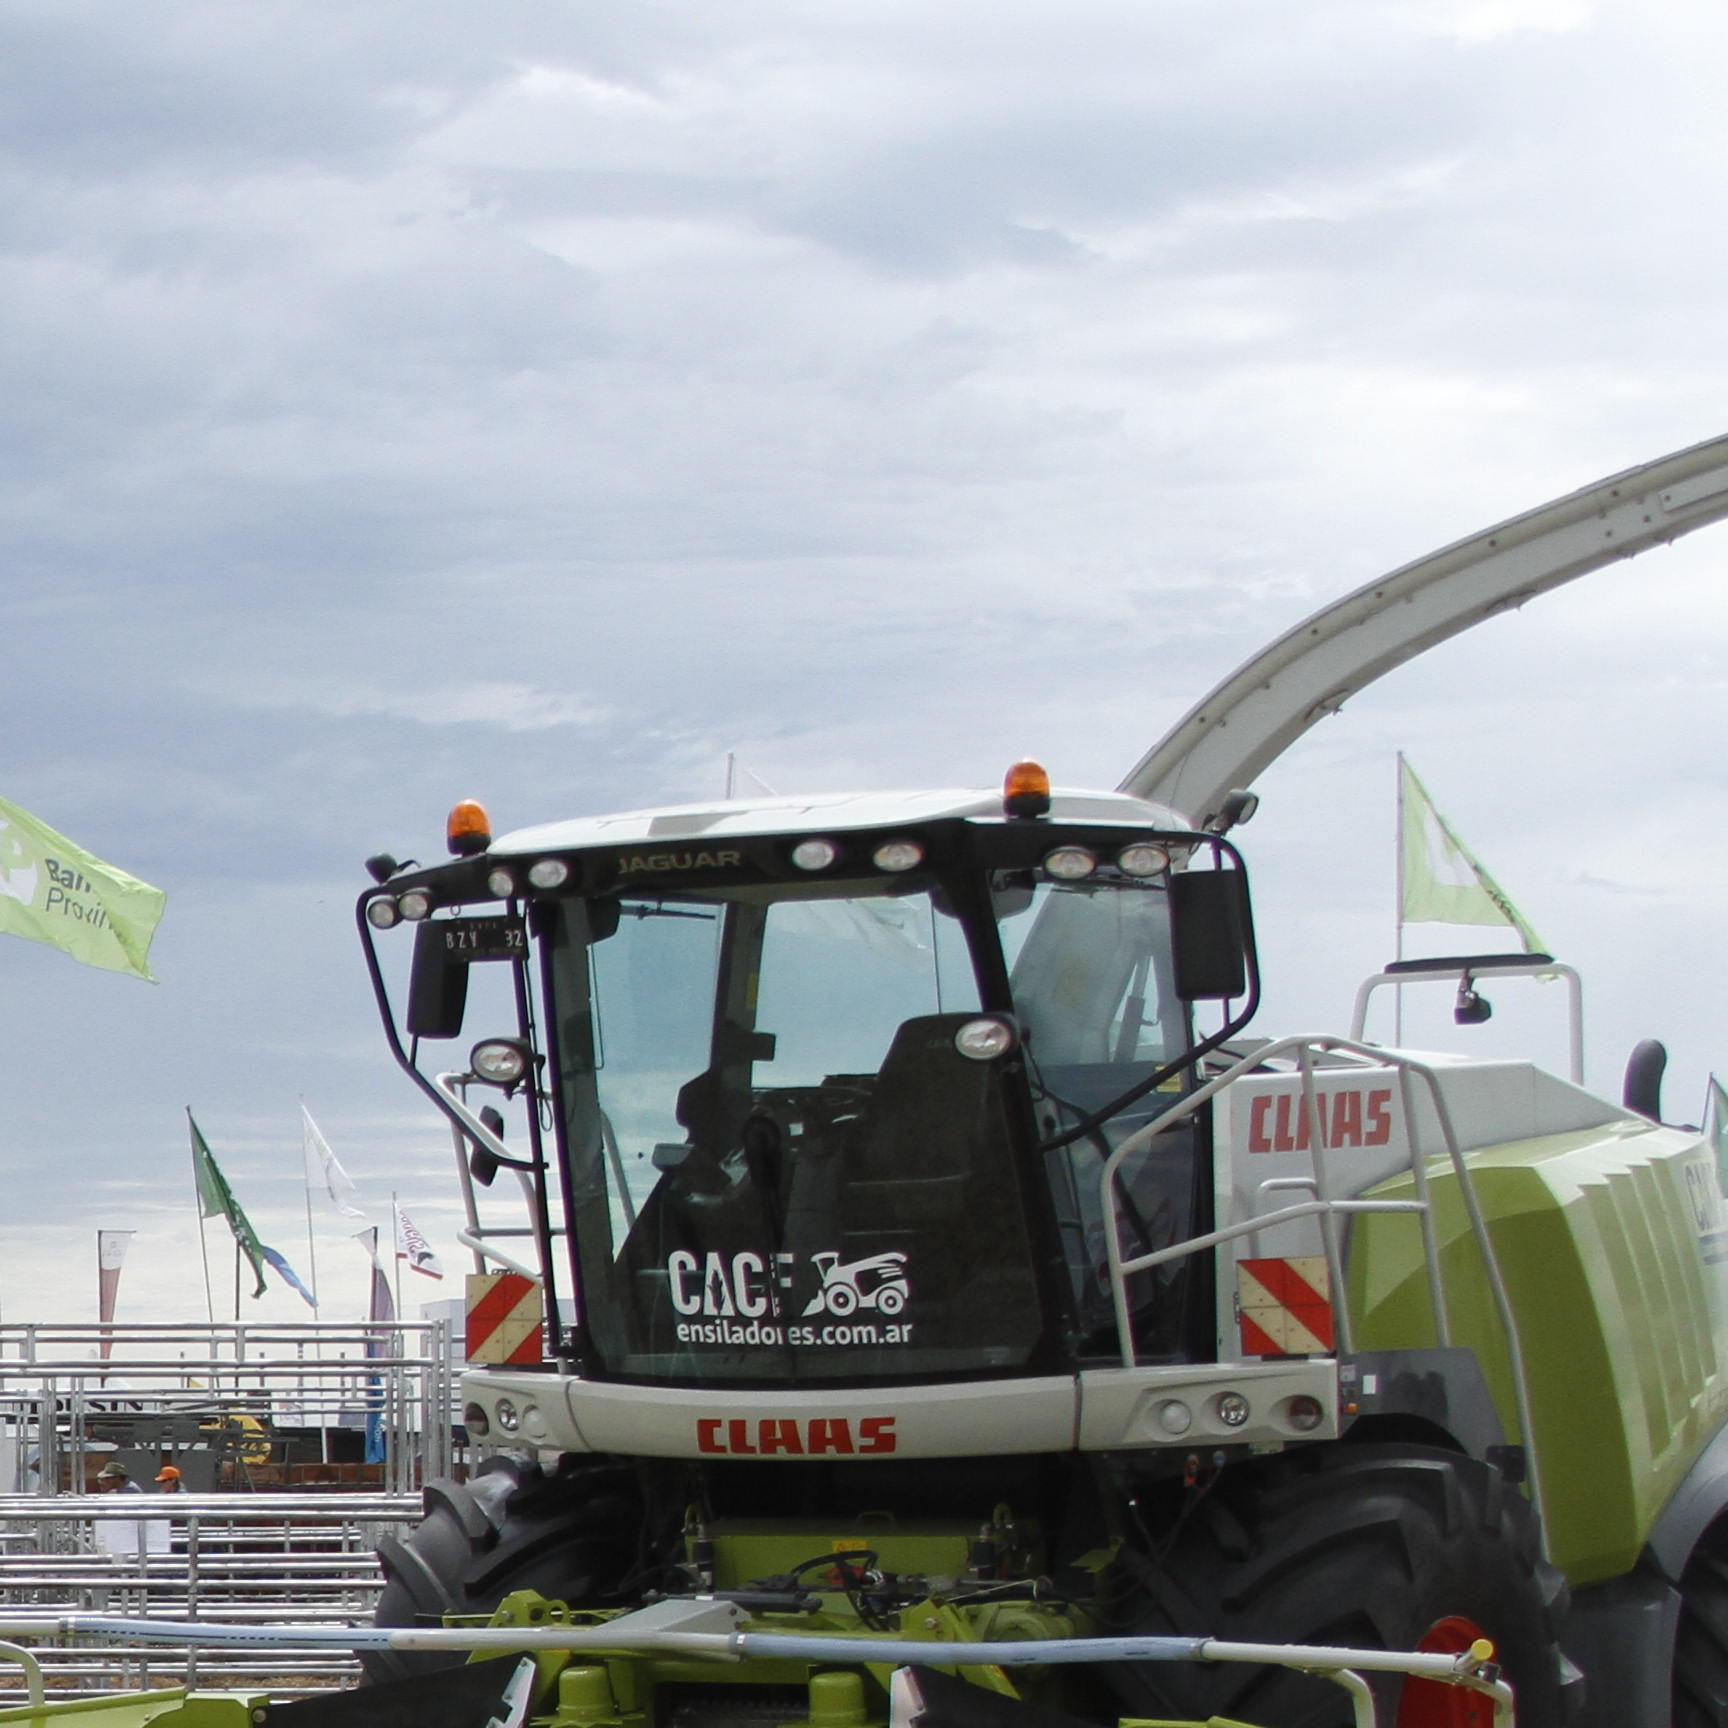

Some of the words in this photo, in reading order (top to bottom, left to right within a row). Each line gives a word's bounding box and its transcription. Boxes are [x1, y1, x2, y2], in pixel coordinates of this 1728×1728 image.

[618, 850, 742, 875] JAGUAR
[1248, 1088, 1393, 1155] CLAAS
[667, 1249, 794, 1318] CACF
[696, 1416, 897, 1455] CLAAS
